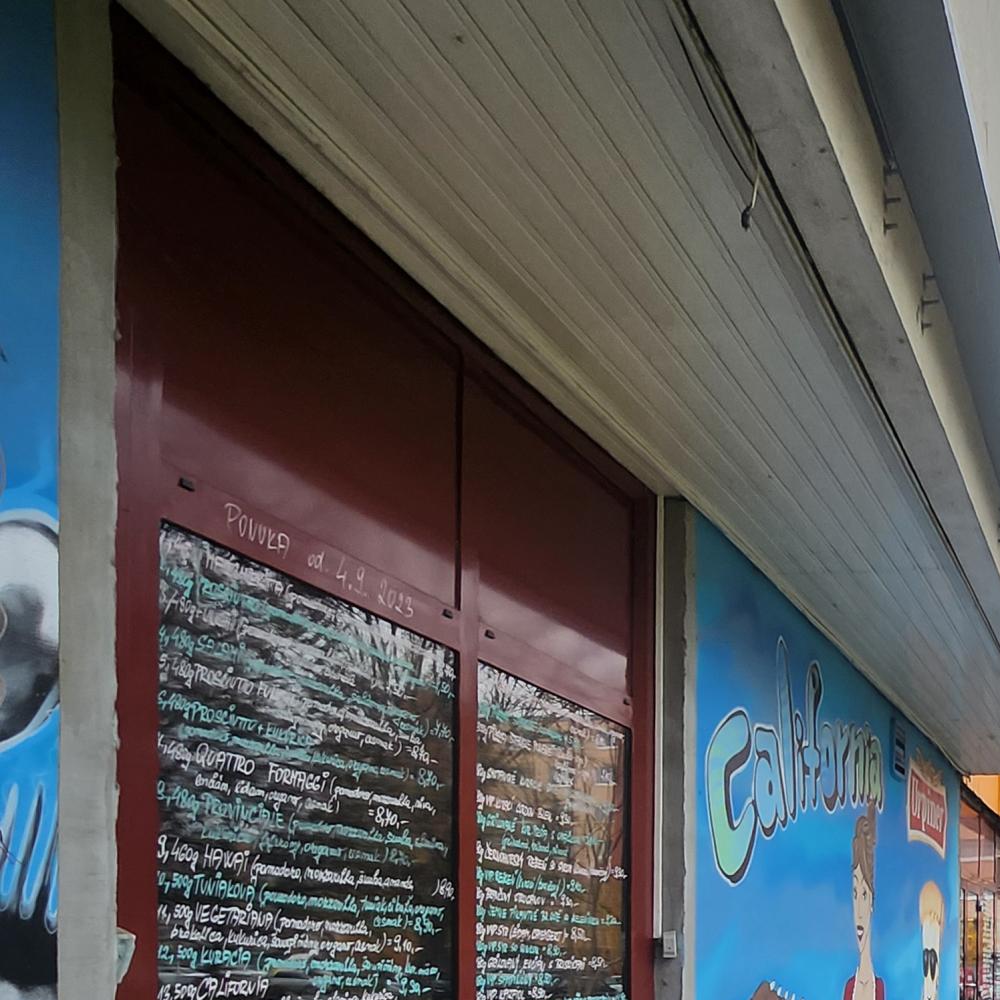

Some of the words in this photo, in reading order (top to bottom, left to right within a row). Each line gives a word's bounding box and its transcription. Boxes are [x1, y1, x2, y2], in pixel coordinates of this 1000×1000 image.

[224, 502, 290, 559] PONUKA
[195, 743, 256, 776] QUATTRO
[267, 761, 331, 793] FORMAGGI
[705, 635, 884, 886] California
[911, 775, 945, 834] Urpiner
[202, 843, 251, 877] HAWAI
